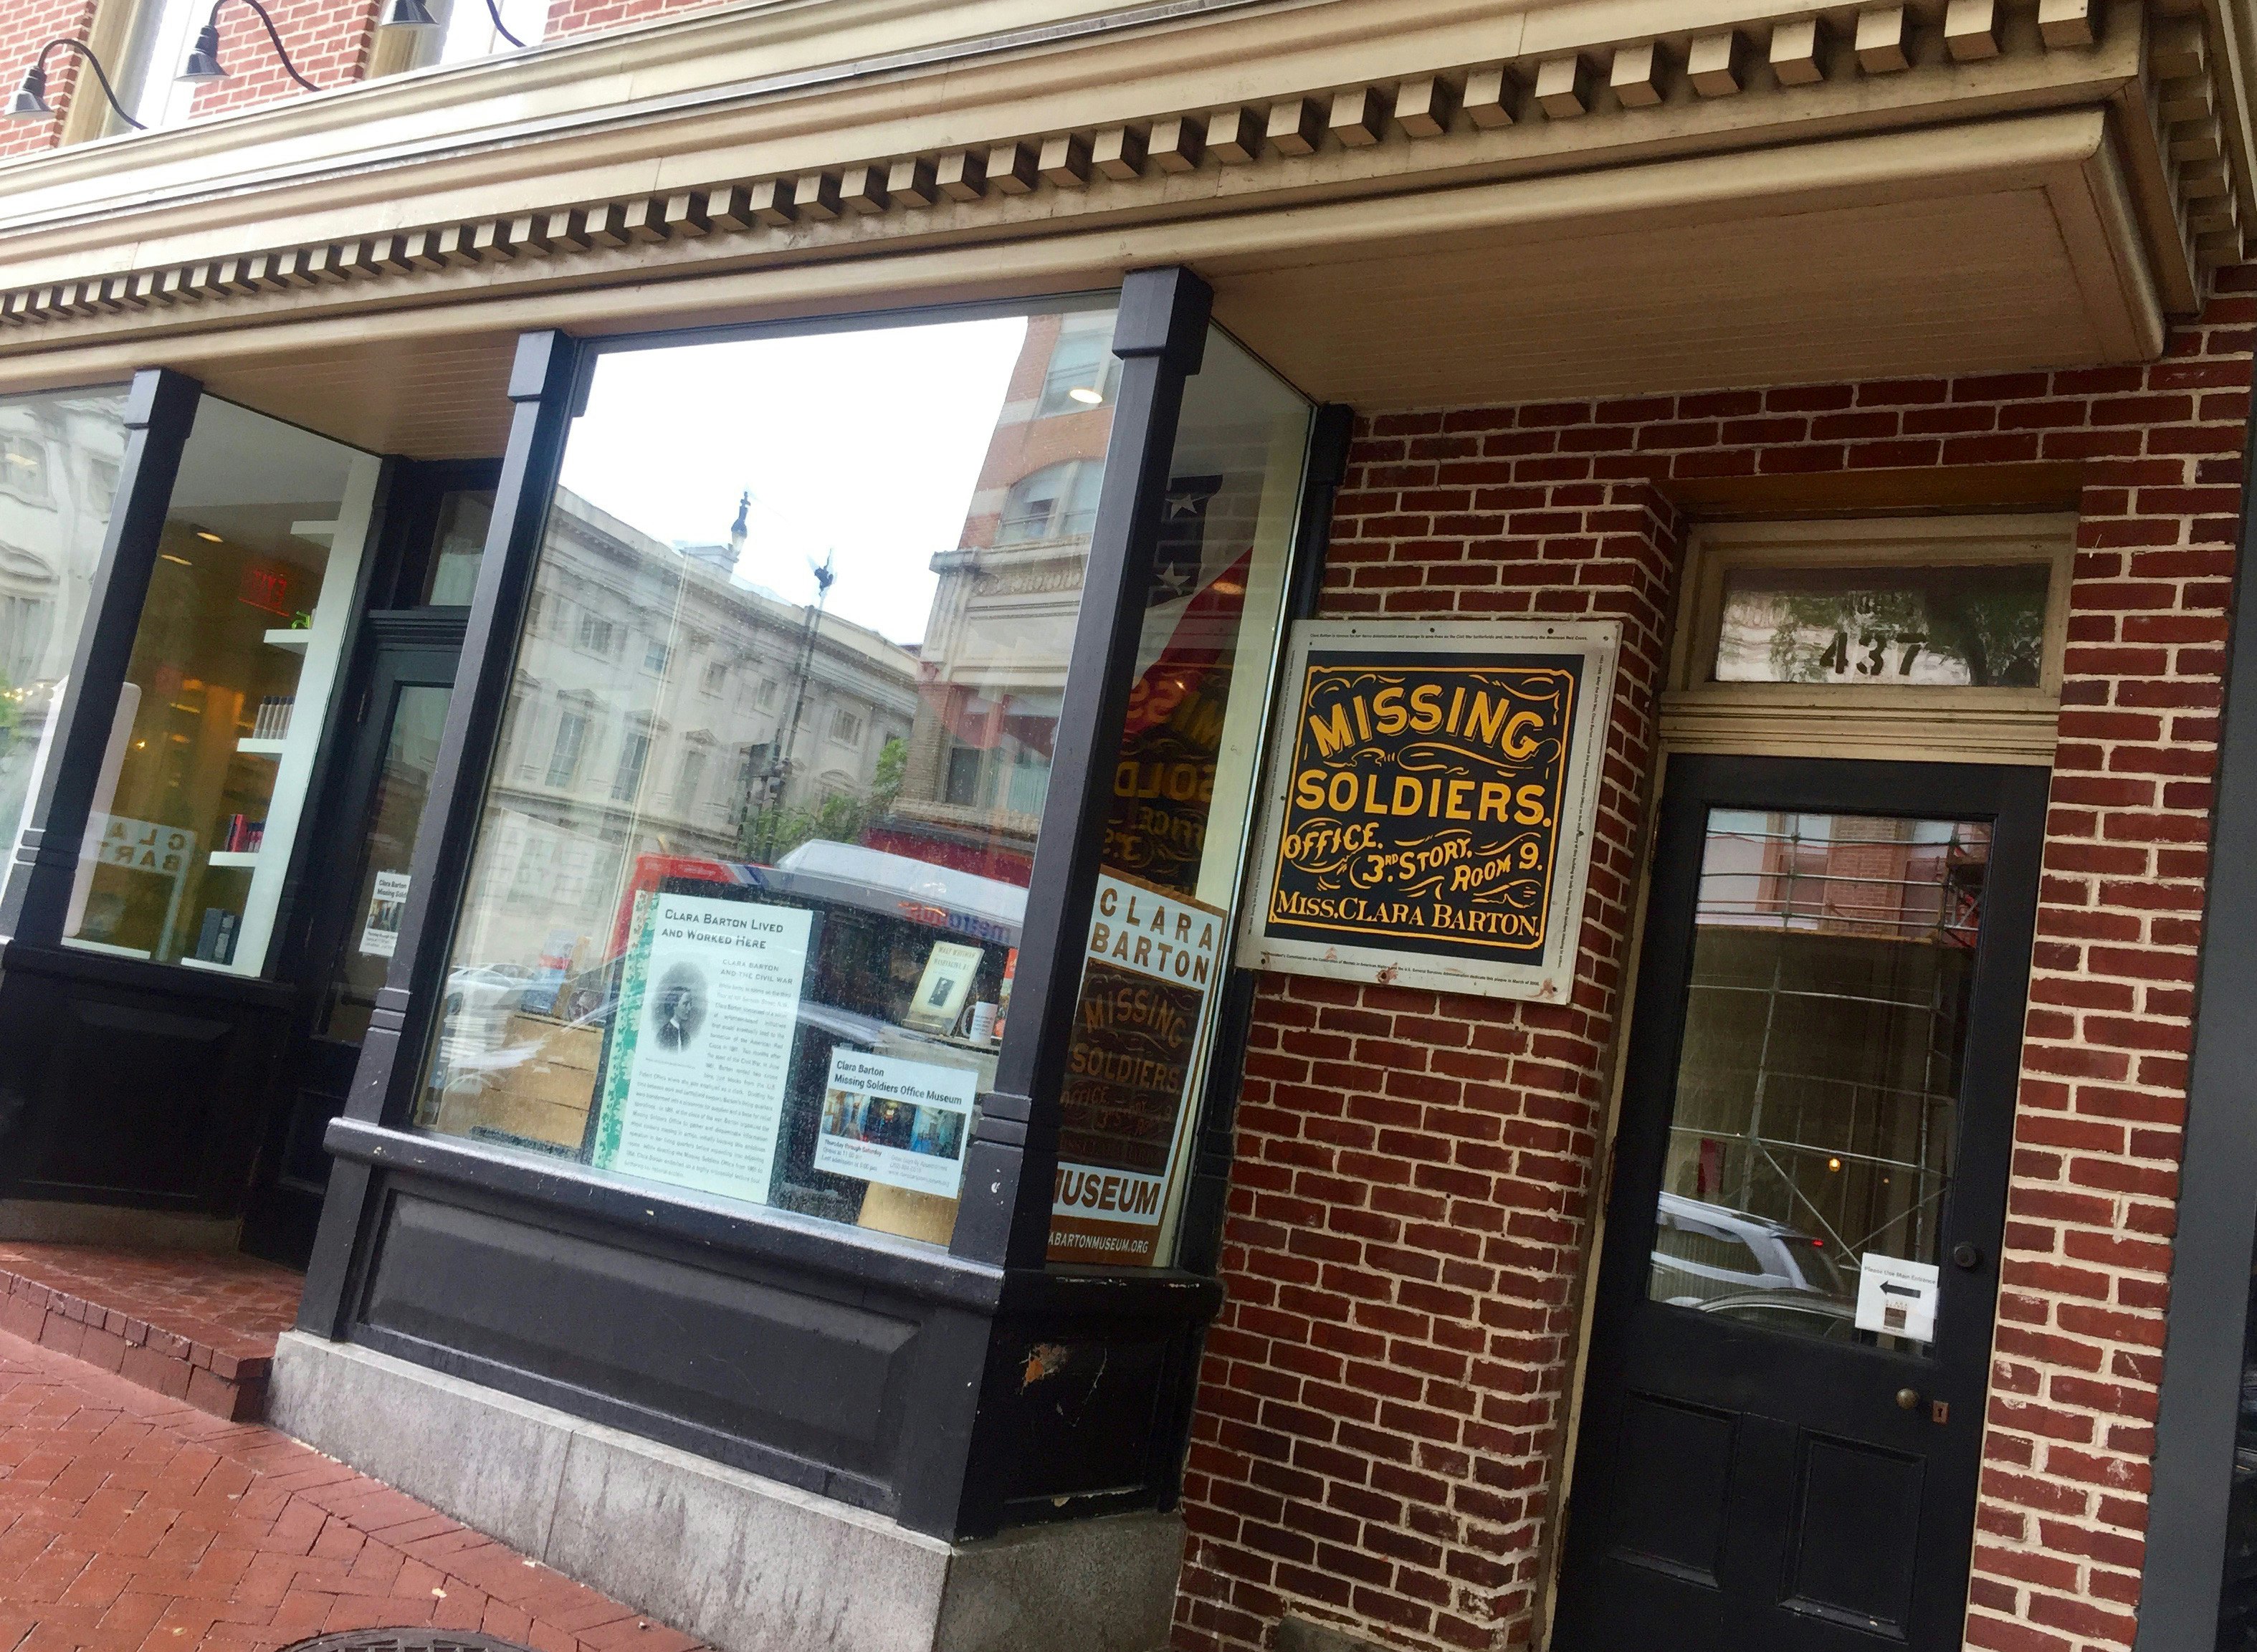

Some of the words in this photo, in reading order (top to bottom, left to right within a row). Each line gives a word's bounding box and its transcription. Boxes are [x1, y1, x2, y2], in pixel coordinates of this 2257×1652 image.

[1820, 632, 1927, 676] 437
[1309, 684, 1545, 760] MISSING
[1296, 769, 1552, 827] SOLDIERS.
[1284, 822, 1383, 861] OFFICE.
[1449, 854, 1512, 892] ROOM
[1517, 842, 1542, 871] 9.
[664, 909, 700, 922] CLARA
[703, 913, 748, 929] BARTON
[750, 919, 784, 933] LIVED
[1099, 887, 1213, 952] CLARA
[1431, 905, 1540, 937] BARTON.
[661, 927, 683, 938] AND
[686, 928, 733, 945] WORKED
[735, 935, 767, 949] HERE
[1089, 922, 1210, 985] BARTON
[748, 962, 779, 972] BARTON
[755, 973, 775, 982] CIVIL
[776, 976, 793, 985] WAR
[1084, 988, 1186, 1049] MISSING
[836, 1059, 857, 1072] Clara
[857, 1064, 884, 1076] Barton
[833, 1073, 865, 1089] Missing
[865, 1079, 899, 1094] Soldiers
[900, 1084, 925, 1098] Office
[925, 1089, 963, 1105] Museum
[1864, 1266, 1884, 1276] Please
[1911, 1275, 1937, 1284] Entrance
